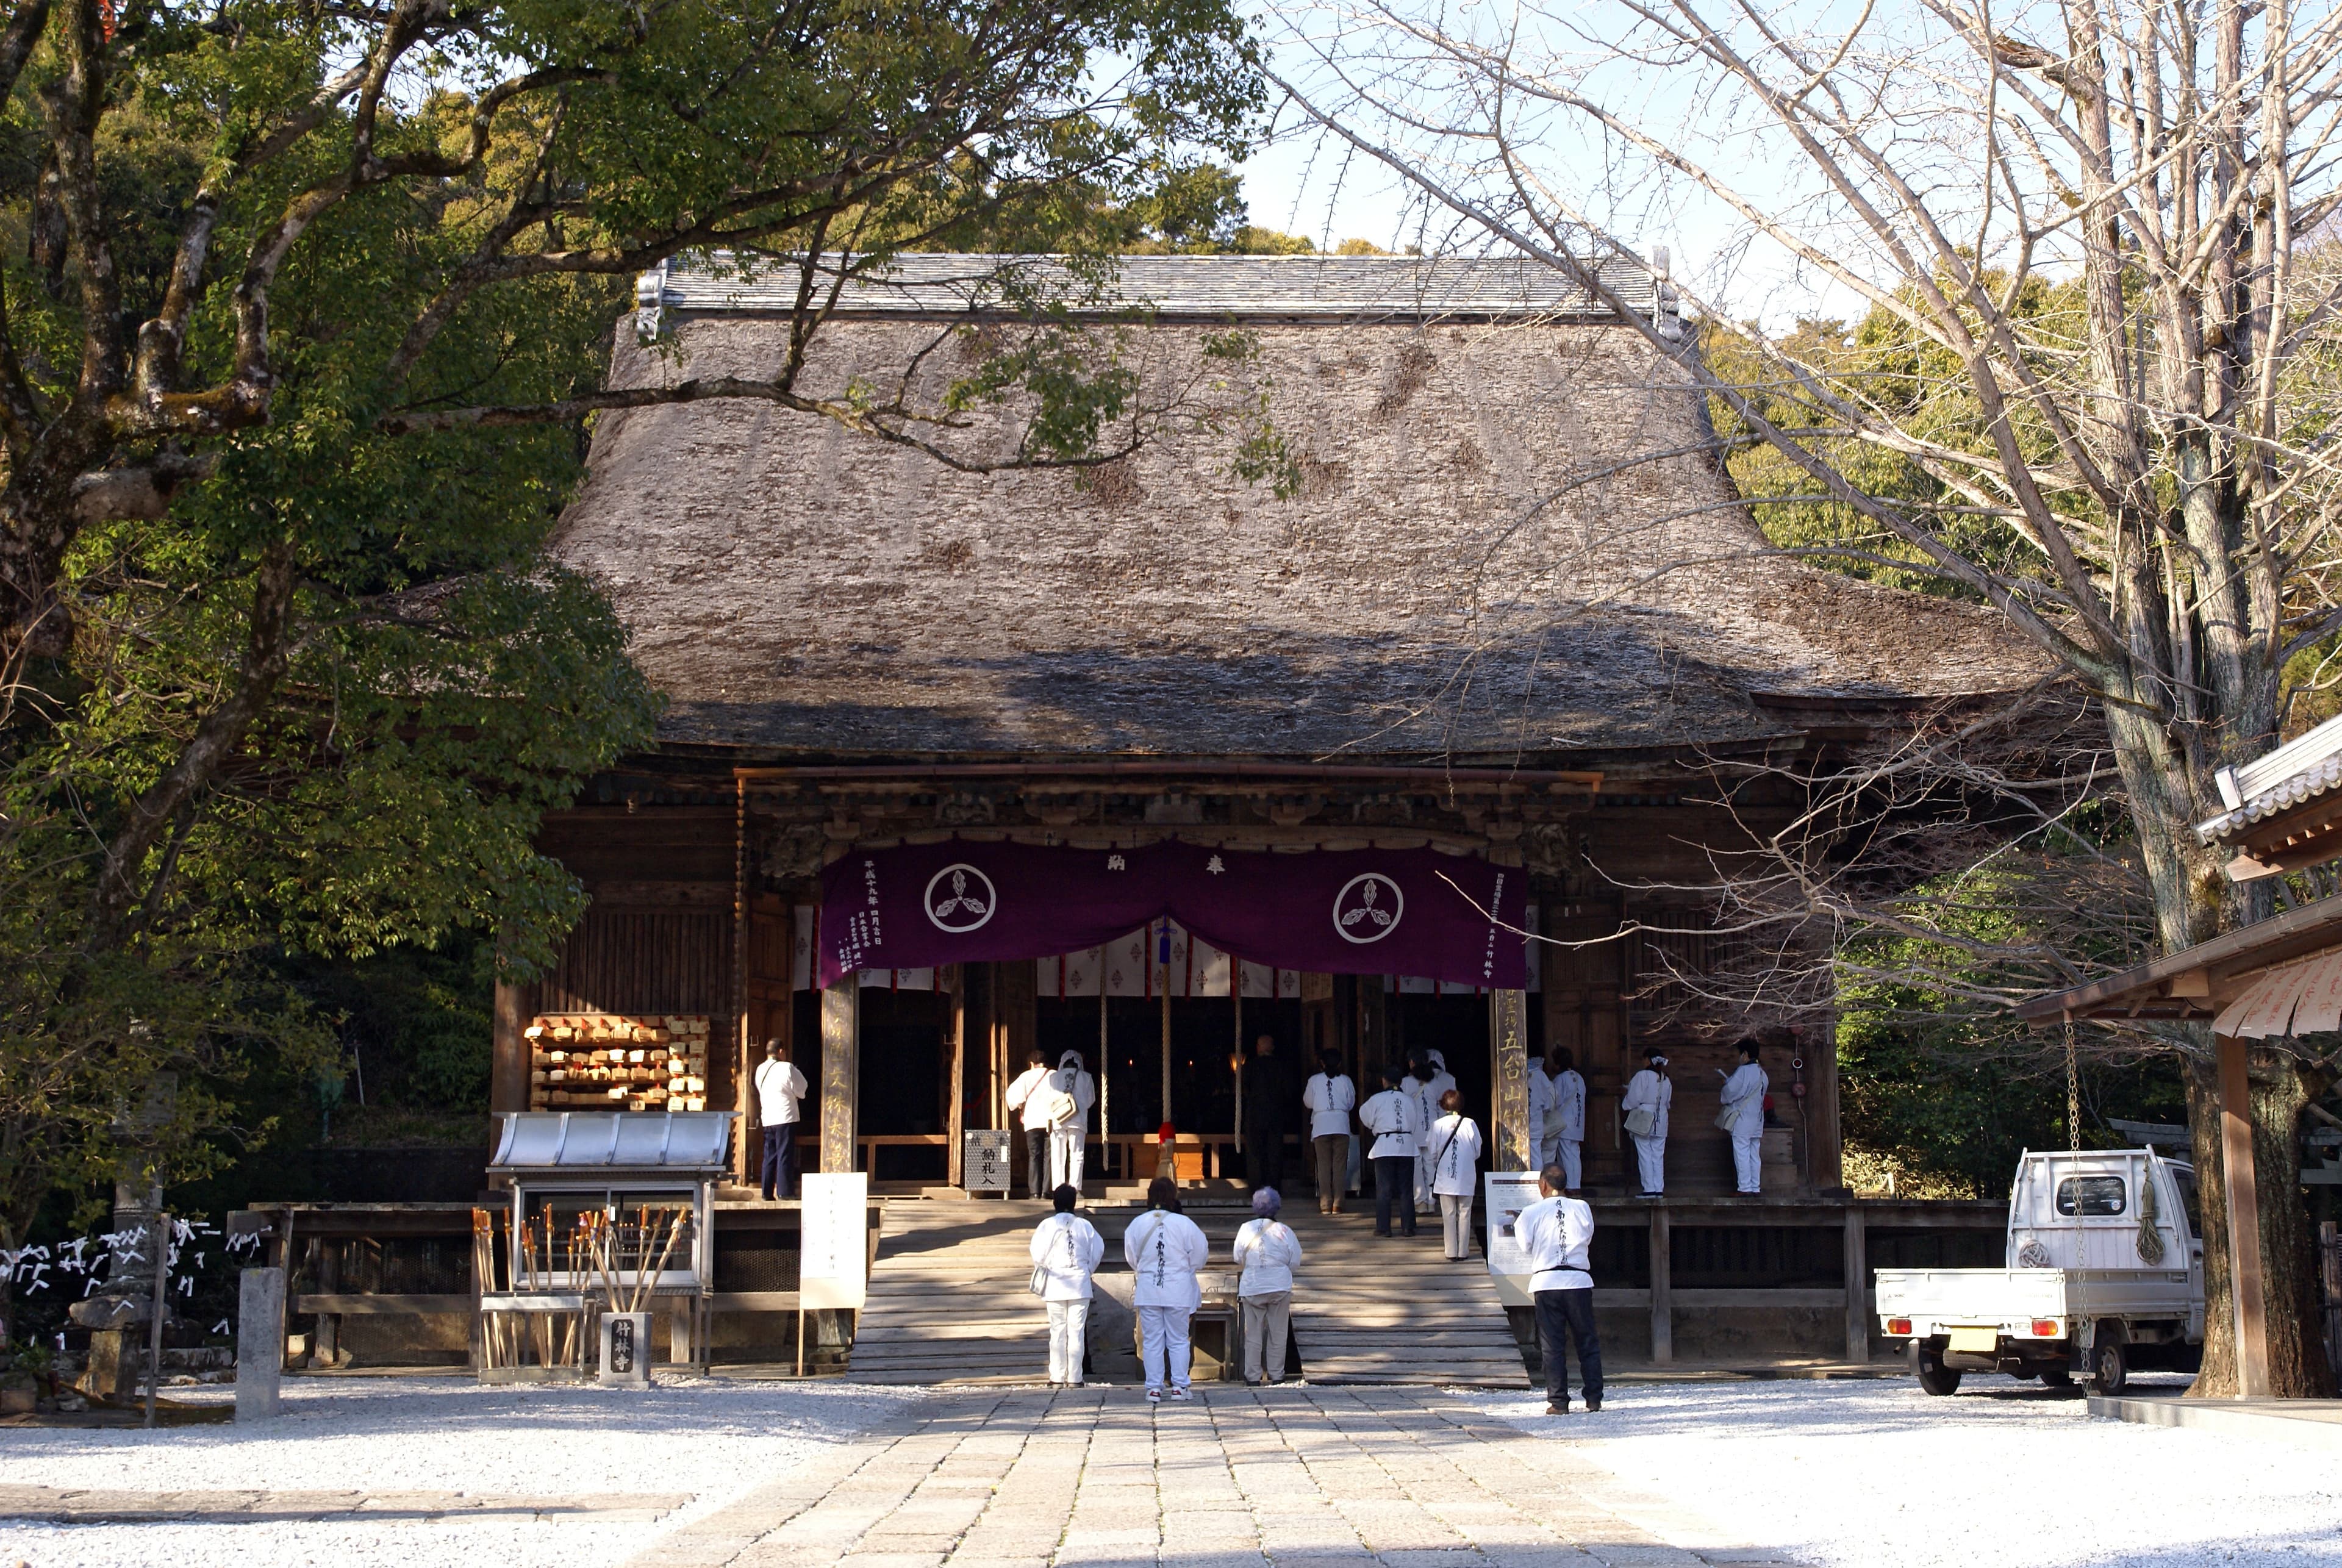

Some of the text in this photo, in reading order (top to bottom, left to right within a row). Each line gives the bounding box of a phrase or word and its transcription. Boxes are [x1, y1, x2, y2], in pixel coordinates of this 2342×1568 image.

[981, 1148, 995, 1185] 納札入
[614, 1322, 631, 1371] 竹林寺
